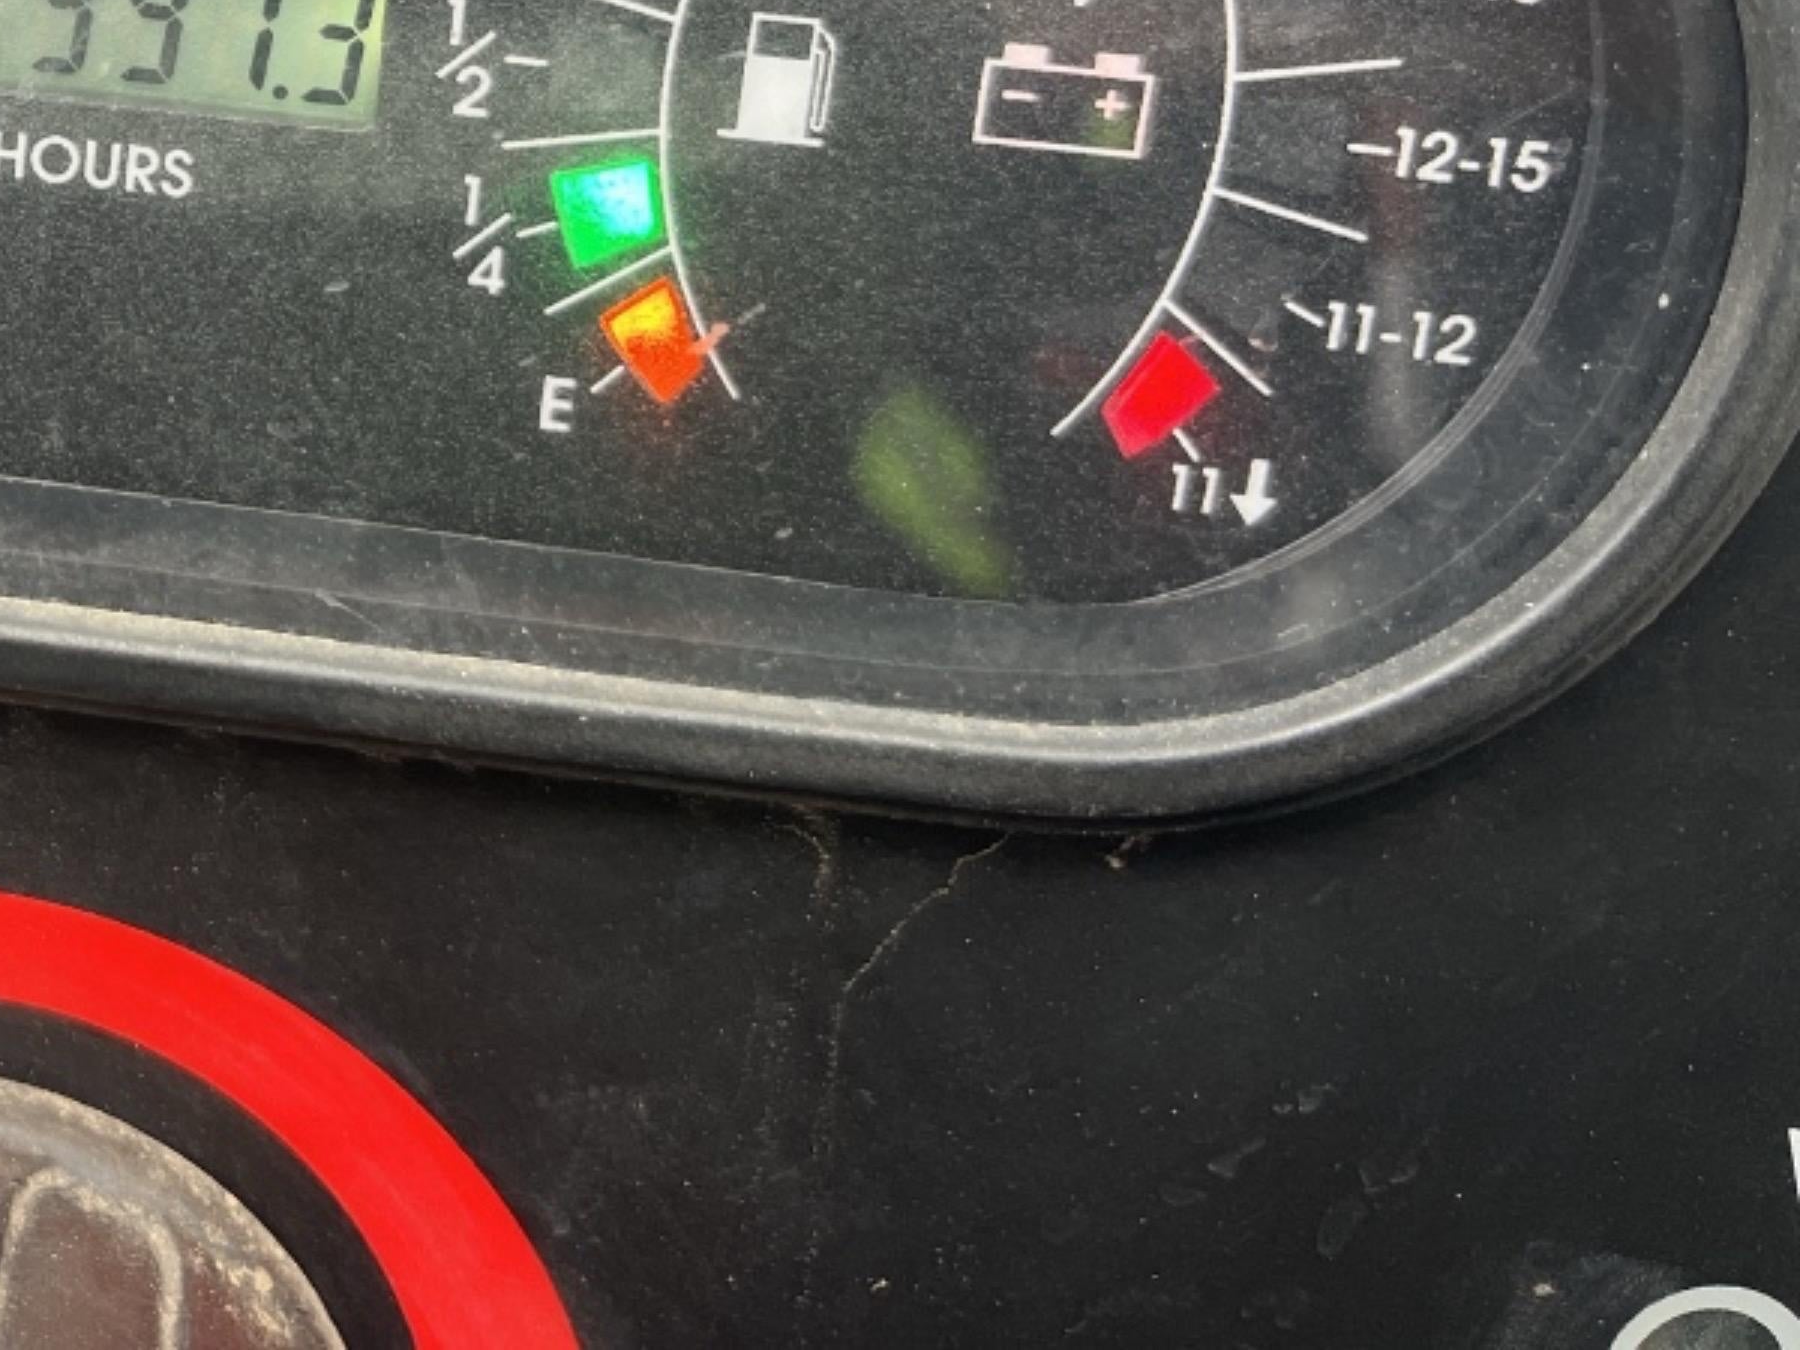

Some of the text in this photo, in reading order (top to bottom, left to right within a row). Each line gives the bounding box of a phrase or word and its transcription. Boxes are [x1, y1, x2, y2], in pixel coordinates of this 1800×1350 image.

[1396, 128, 1550, 192] 12-15
[1326, 303, 1475, 365] 11-12
[539, 376, 576, 433] E
